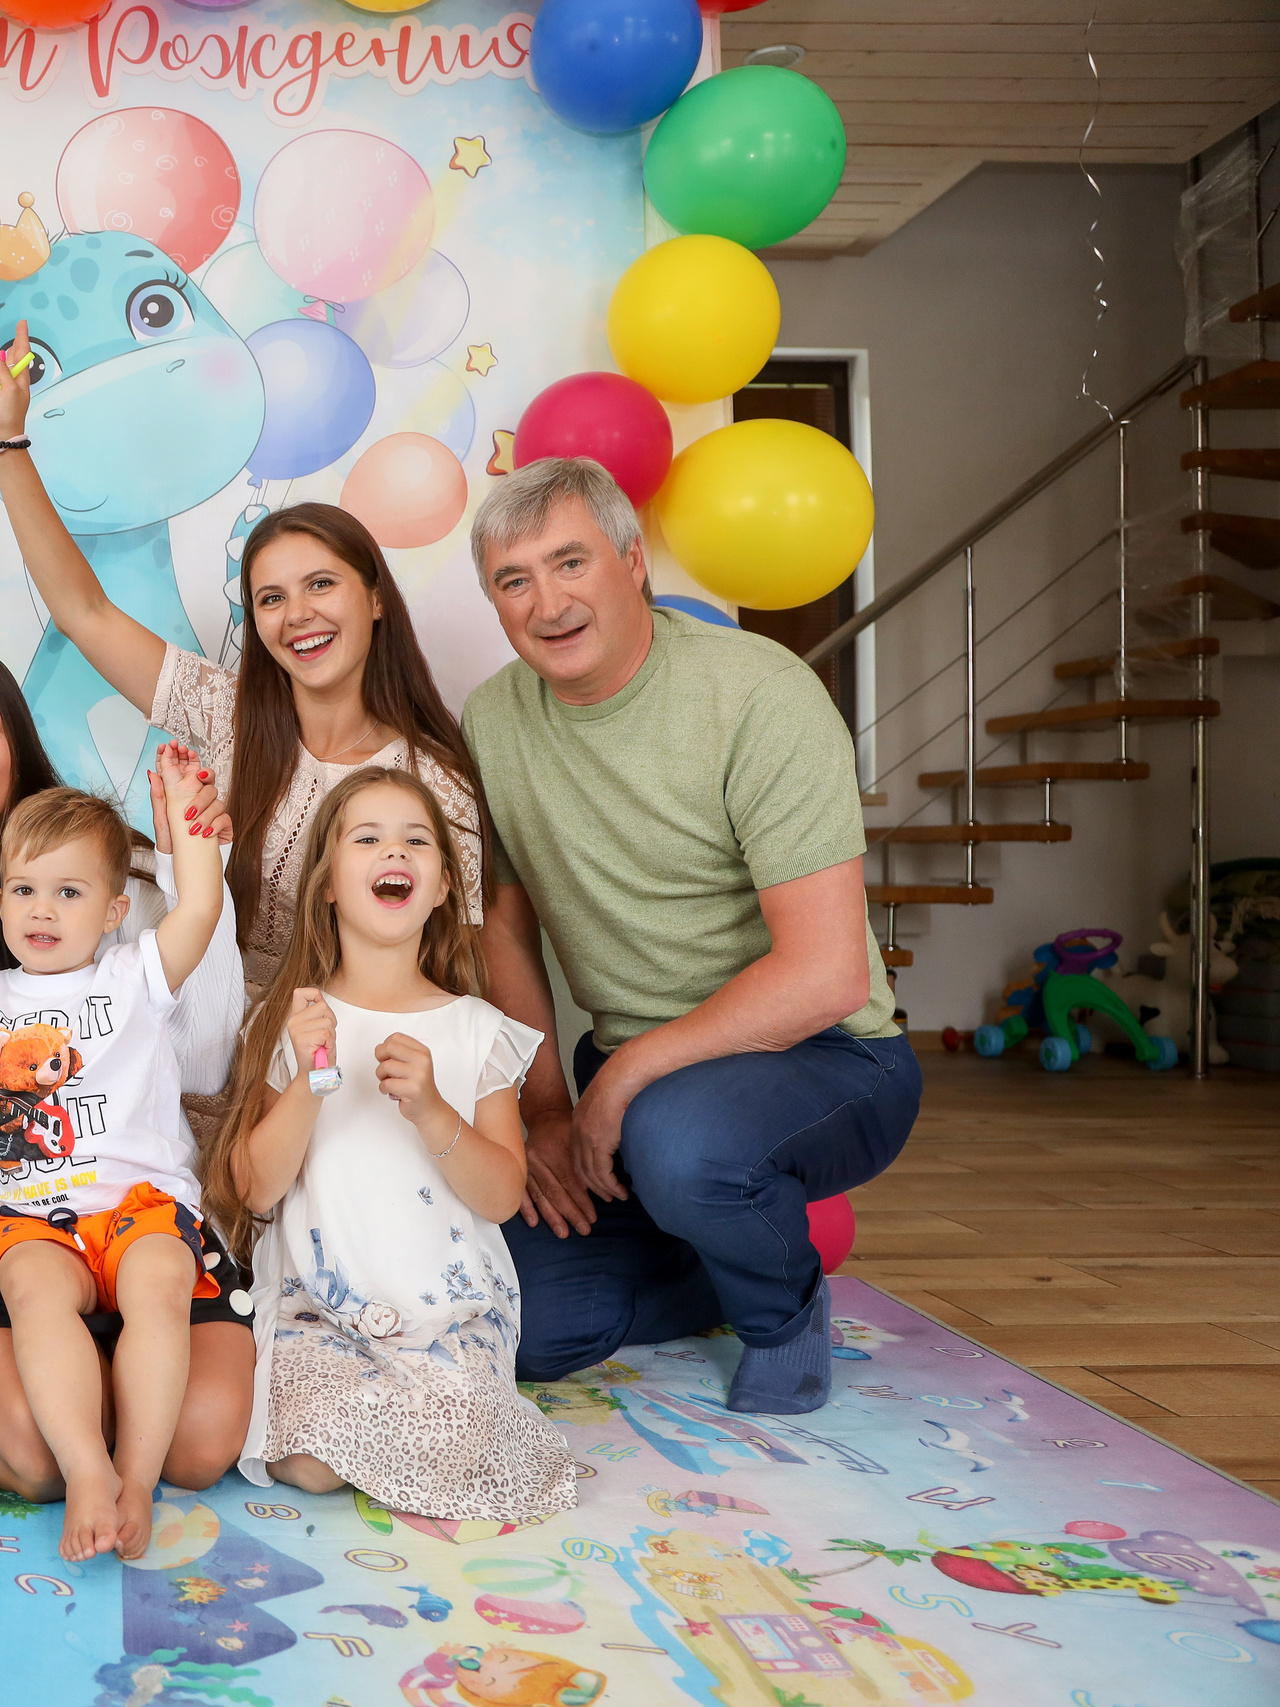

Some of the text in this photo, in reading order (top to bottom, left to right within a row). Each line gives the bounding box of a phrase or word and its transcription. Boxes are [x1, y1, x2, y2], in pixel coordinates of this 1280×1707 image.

[85, 1, 532, 116] Рождения
[79, 996, 114, 1040] IT
[21, 1182, 52, 1200] HAVE
[55, 1177, 68, 1192] IS
[71, 1170, 97, 1188] NOW
[42, 1198, 51, 1206] BE
[52, 1194, 70, 1204] COOL
[586, 1443, 641, 1462] 4
[243, 1500, 303, 1521] B
[561, 1537, 620, 1564] 6
[14, 1573, 75, 1597] C
[888, 1585, 974, 1618] 5
[302, 1630, 375, 1658] F
